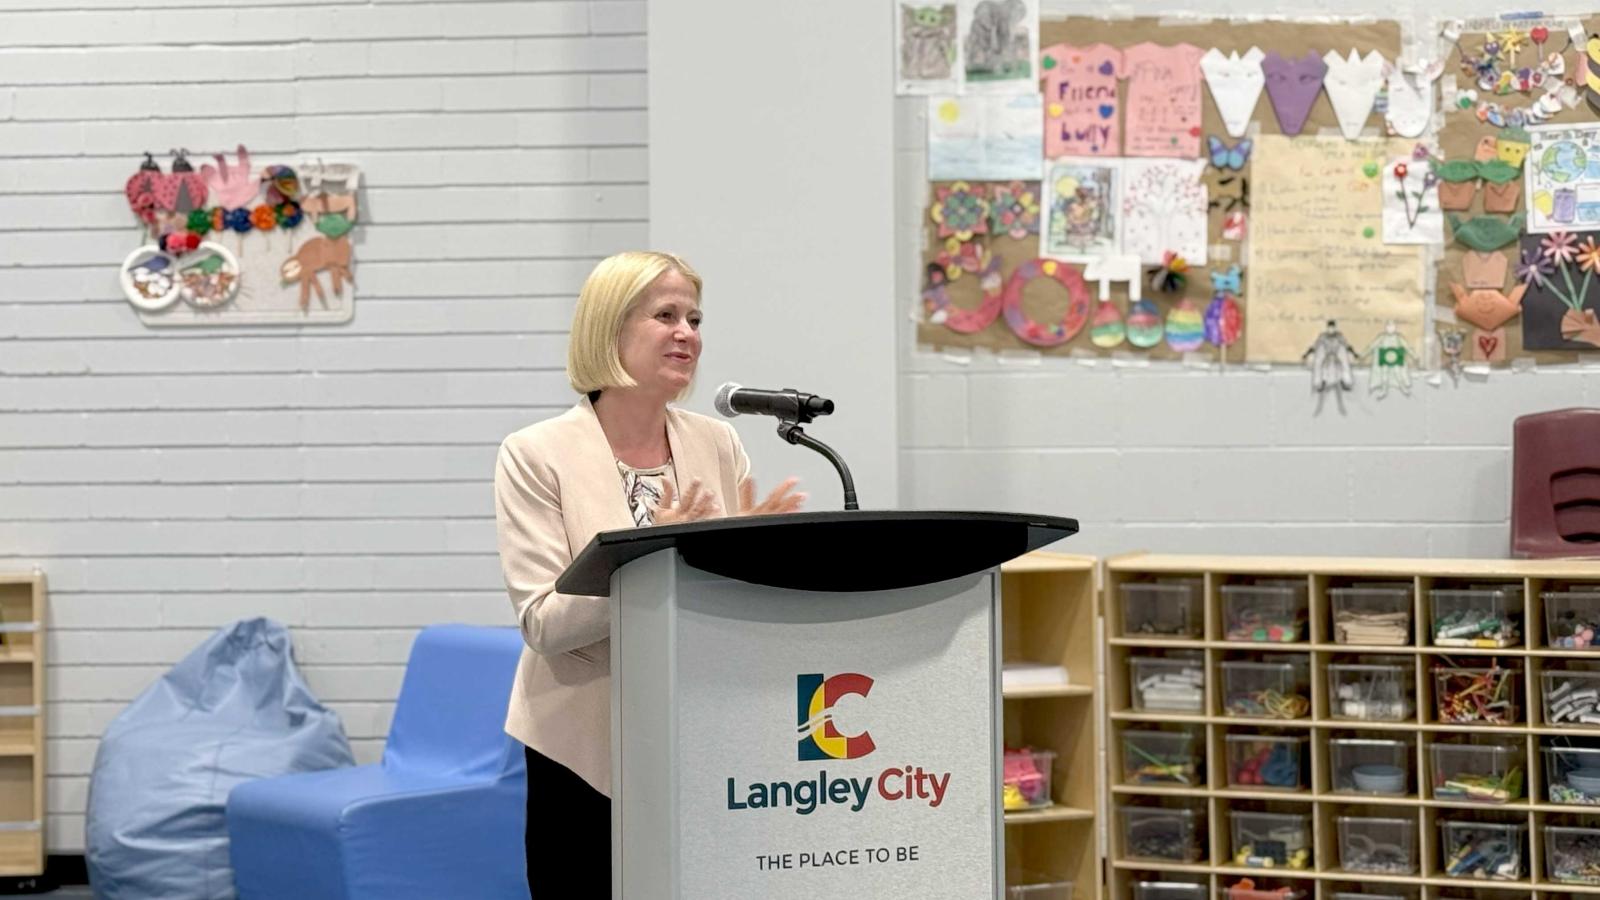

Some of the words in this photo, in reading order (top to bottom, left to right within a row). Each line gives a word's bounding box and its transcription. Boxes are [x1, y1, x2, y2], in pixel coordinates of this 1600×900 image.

[1061, 122, 1111, 149] bully
[727, 770, 873, 815] Langley
[877, 764, 951, 808] City
[756, 854, 793, 871] THE
[799, 850, 860, 868] PLACE
[865, 847, 890, 864] TO
[896, 845, 920, 862] BE
